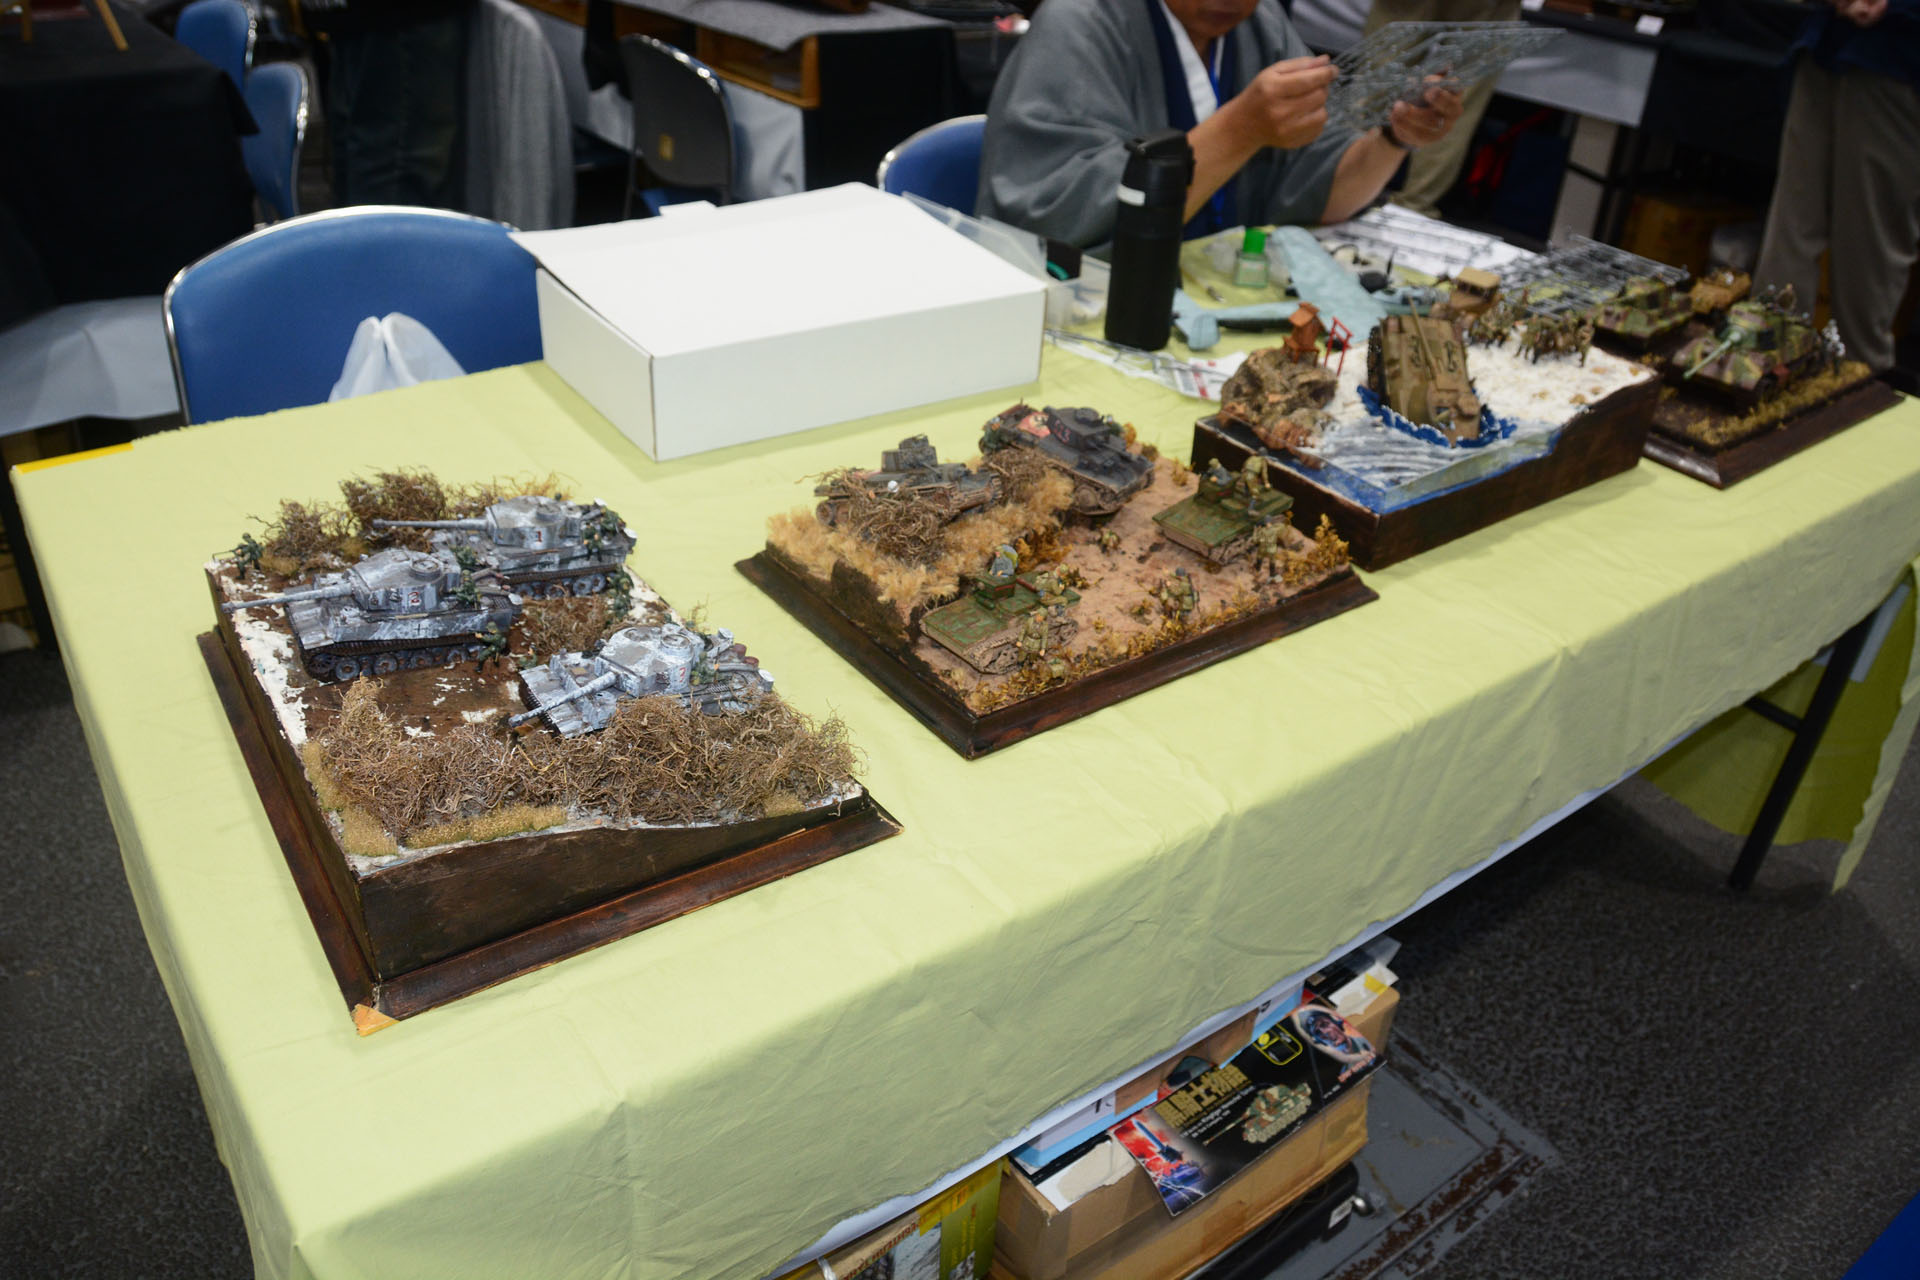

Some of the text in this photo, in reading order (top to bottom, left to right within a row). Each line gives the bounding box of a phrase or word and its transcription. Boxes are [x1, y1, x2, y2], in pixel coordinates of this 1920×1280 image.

[1153, 1064, 1248, 1129] 黒騎士物語
